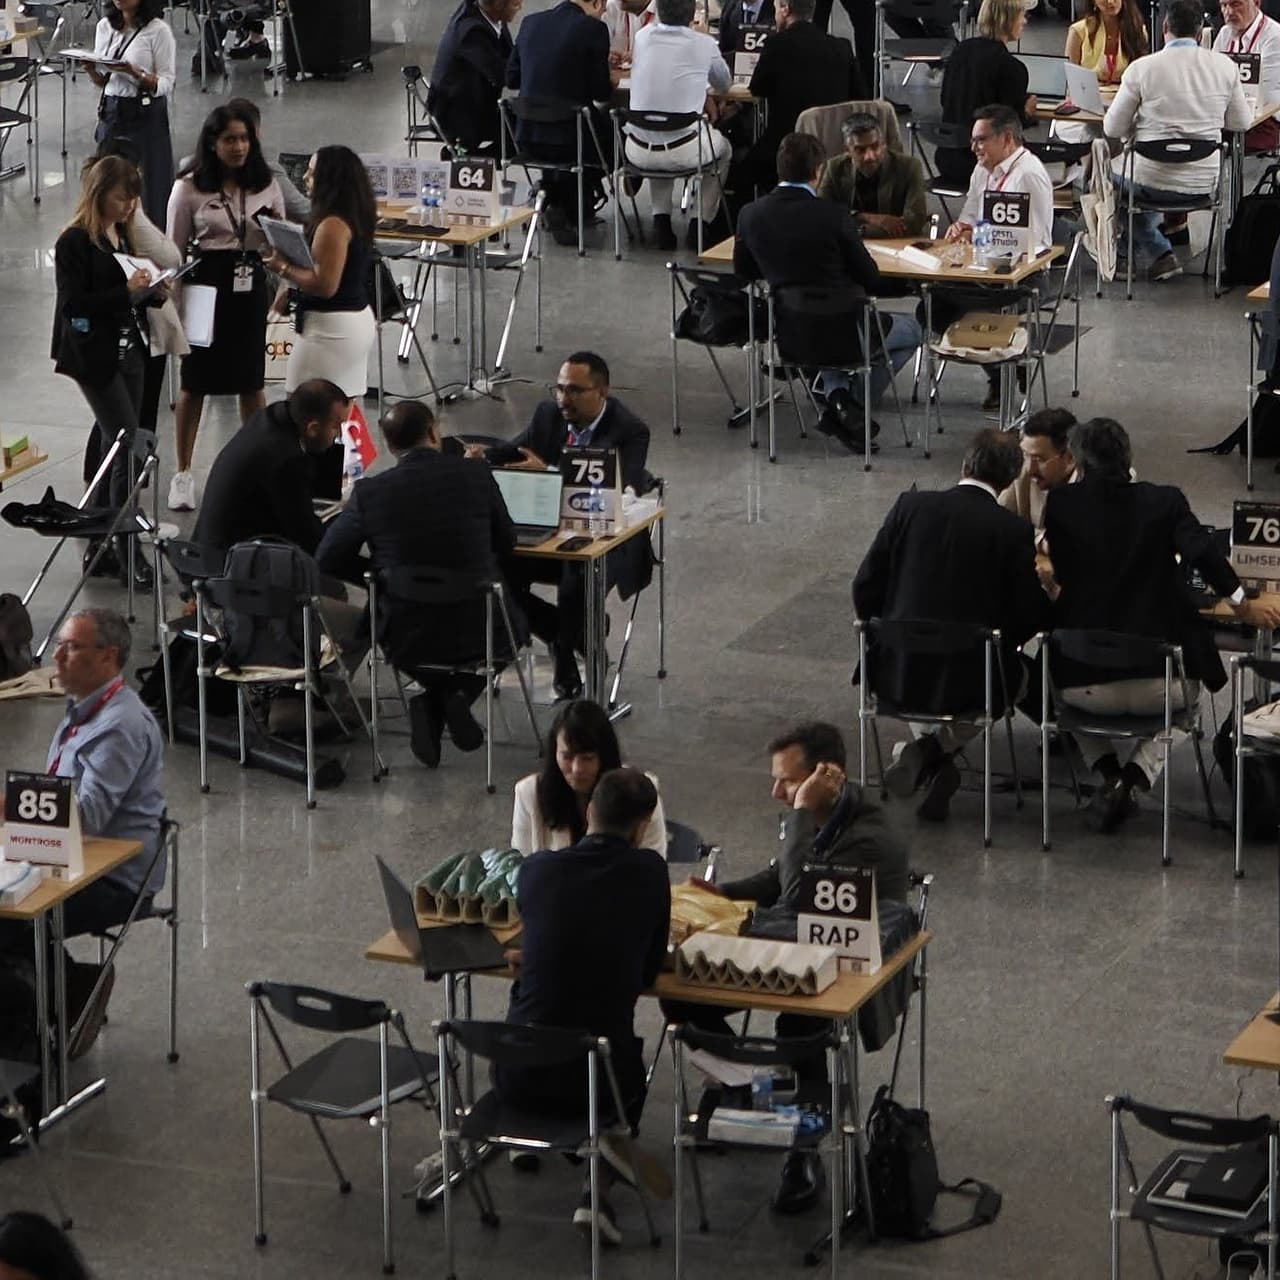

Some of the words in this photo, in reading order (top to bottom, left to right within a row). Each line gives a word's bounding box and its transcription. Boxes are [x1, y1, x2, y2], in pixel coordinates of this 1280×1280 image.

[457, 167, 485, 188] 64
[991, 202, 1020, 224] 65
[571, 459, 605, 484] 75
[1245, 517, 1280, 543] 76
[18, 788, 58, 820] 85
[10, 835, 62, 848] MONTROSE
[813, 880, 857, 913] 86
[809, 923, 860, 948] RAP
